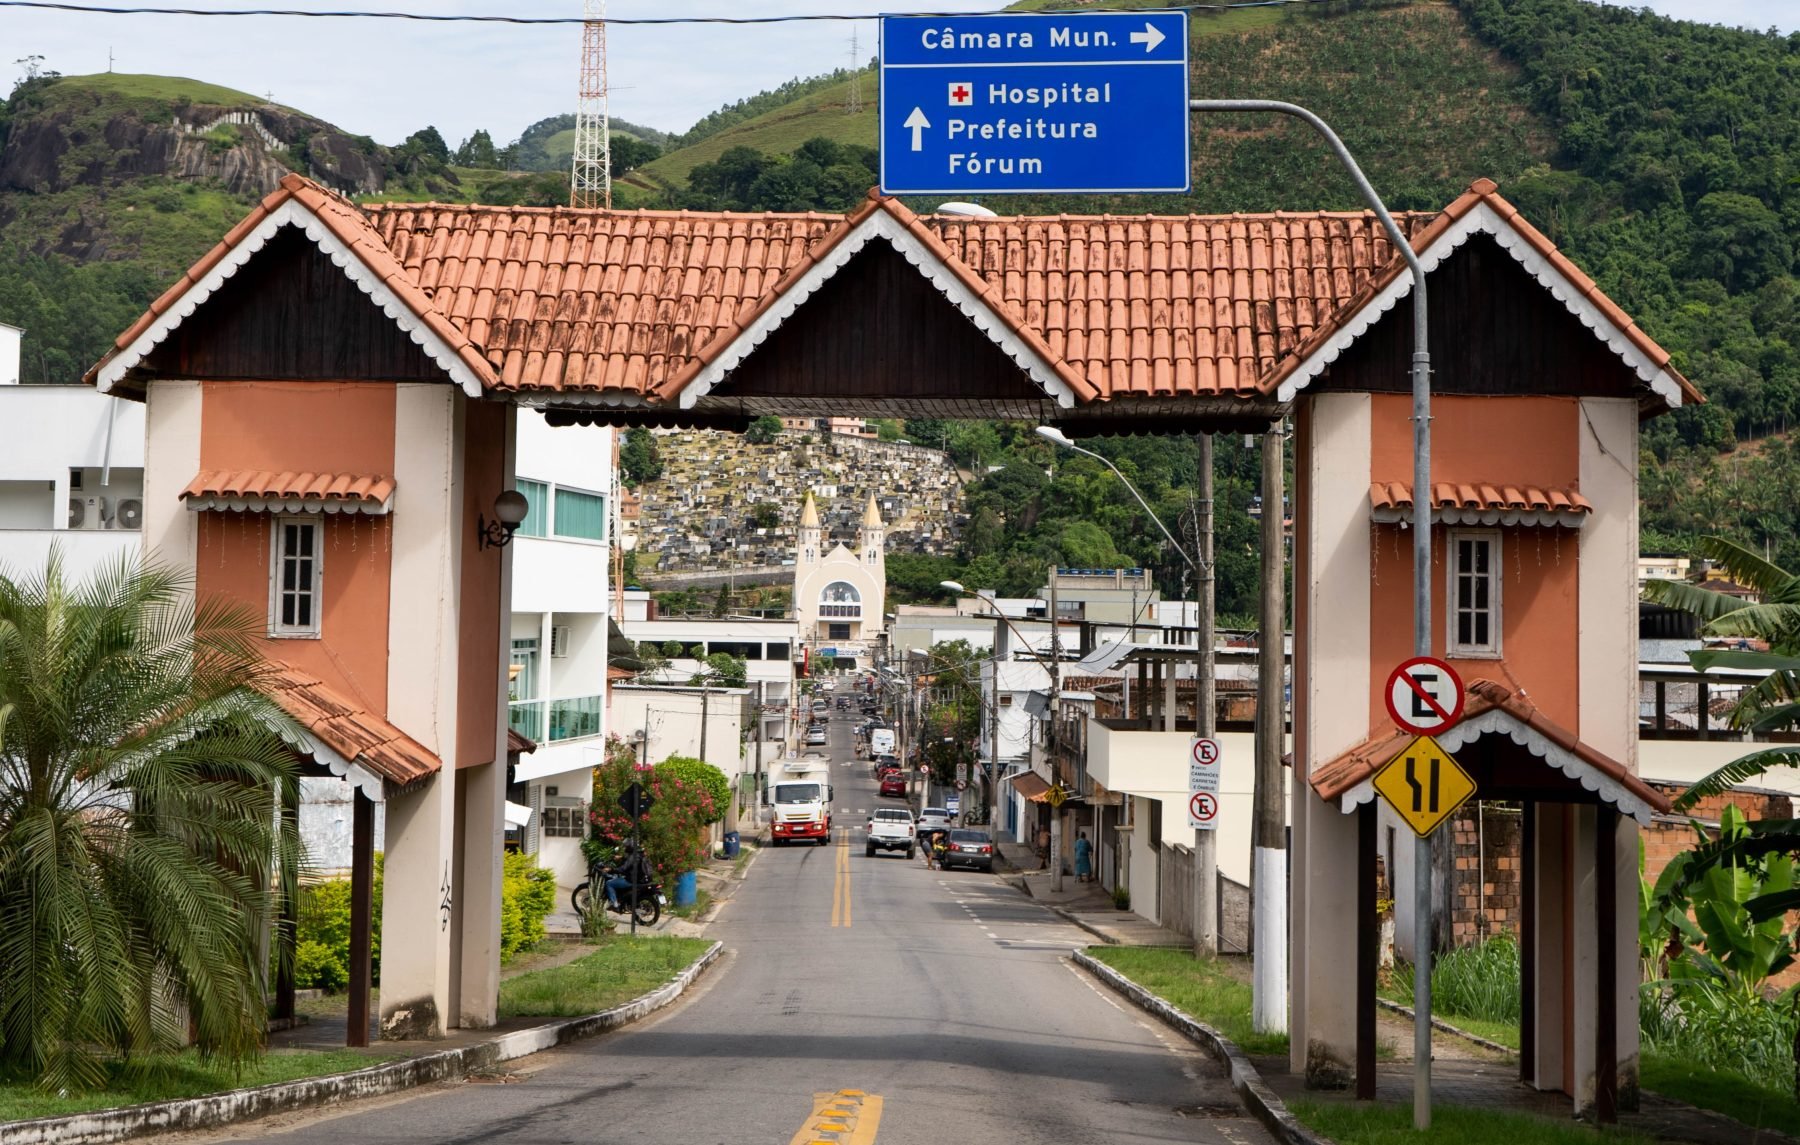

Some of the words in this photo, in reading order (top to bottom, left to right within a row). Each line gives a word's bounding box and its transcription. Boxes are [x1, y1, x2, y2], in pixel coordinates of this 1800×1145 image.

[922, 28, 1032, 49] Câmara
[1050, 27, 1116, 47] Mun.
[990, 83, 1110, 108] Hospital
[949, 119, 1096, 139] Prefeitura
[950, 152, 1041, 174] Fórum
[1412, 675, 1438, 717] E
